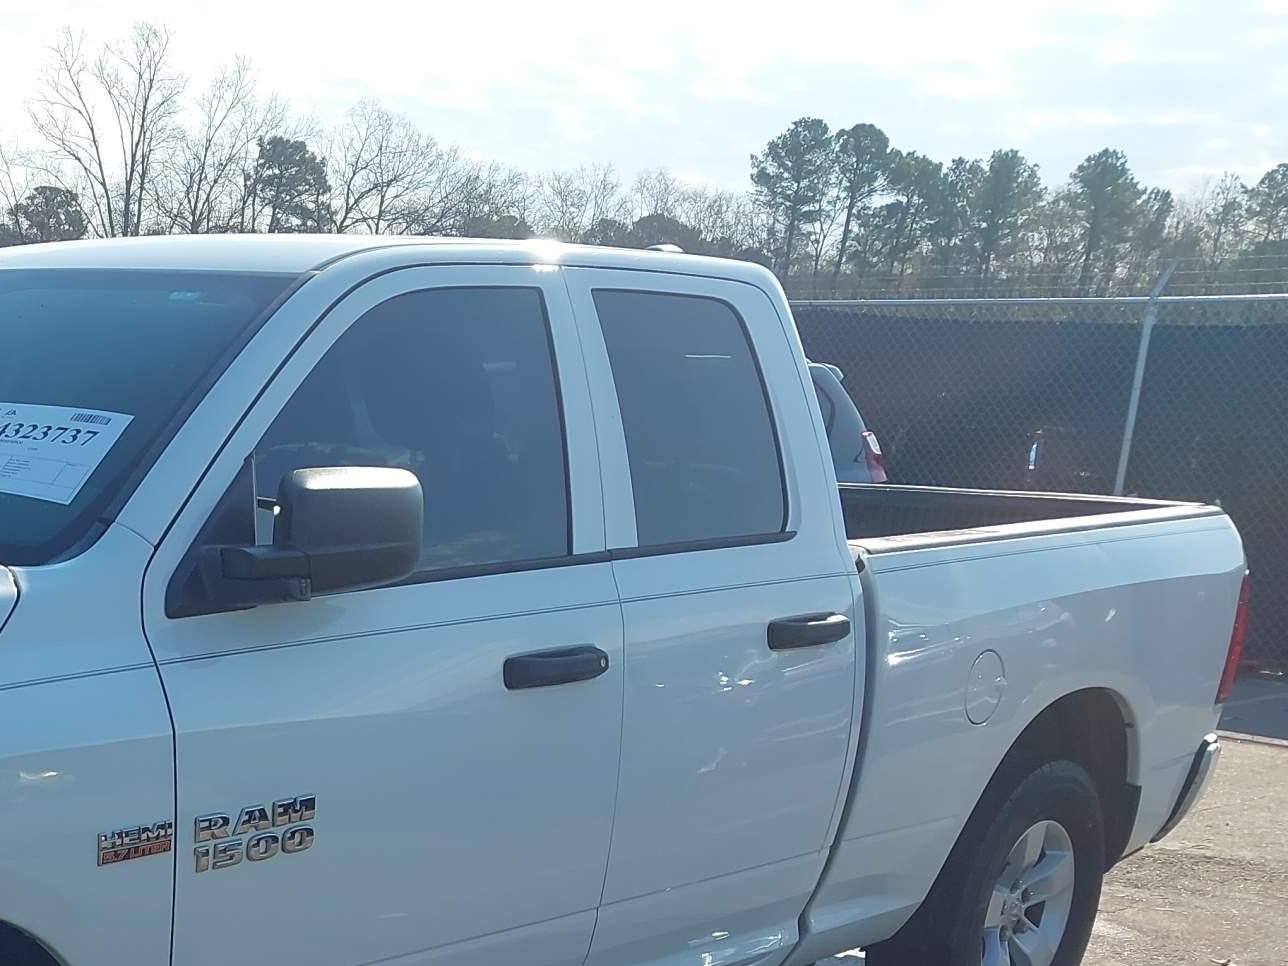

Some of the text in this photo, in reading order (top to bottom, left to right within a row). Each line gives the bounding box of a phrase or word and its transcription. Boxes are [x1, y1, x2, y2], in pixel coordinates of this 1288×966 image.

[99, 820, 173, 850] HEMI
[194, 792, 317, 843] RAM
[103, 841, 170, 862] 5.7 LITER
[193, 824, 315, 873] 1500
